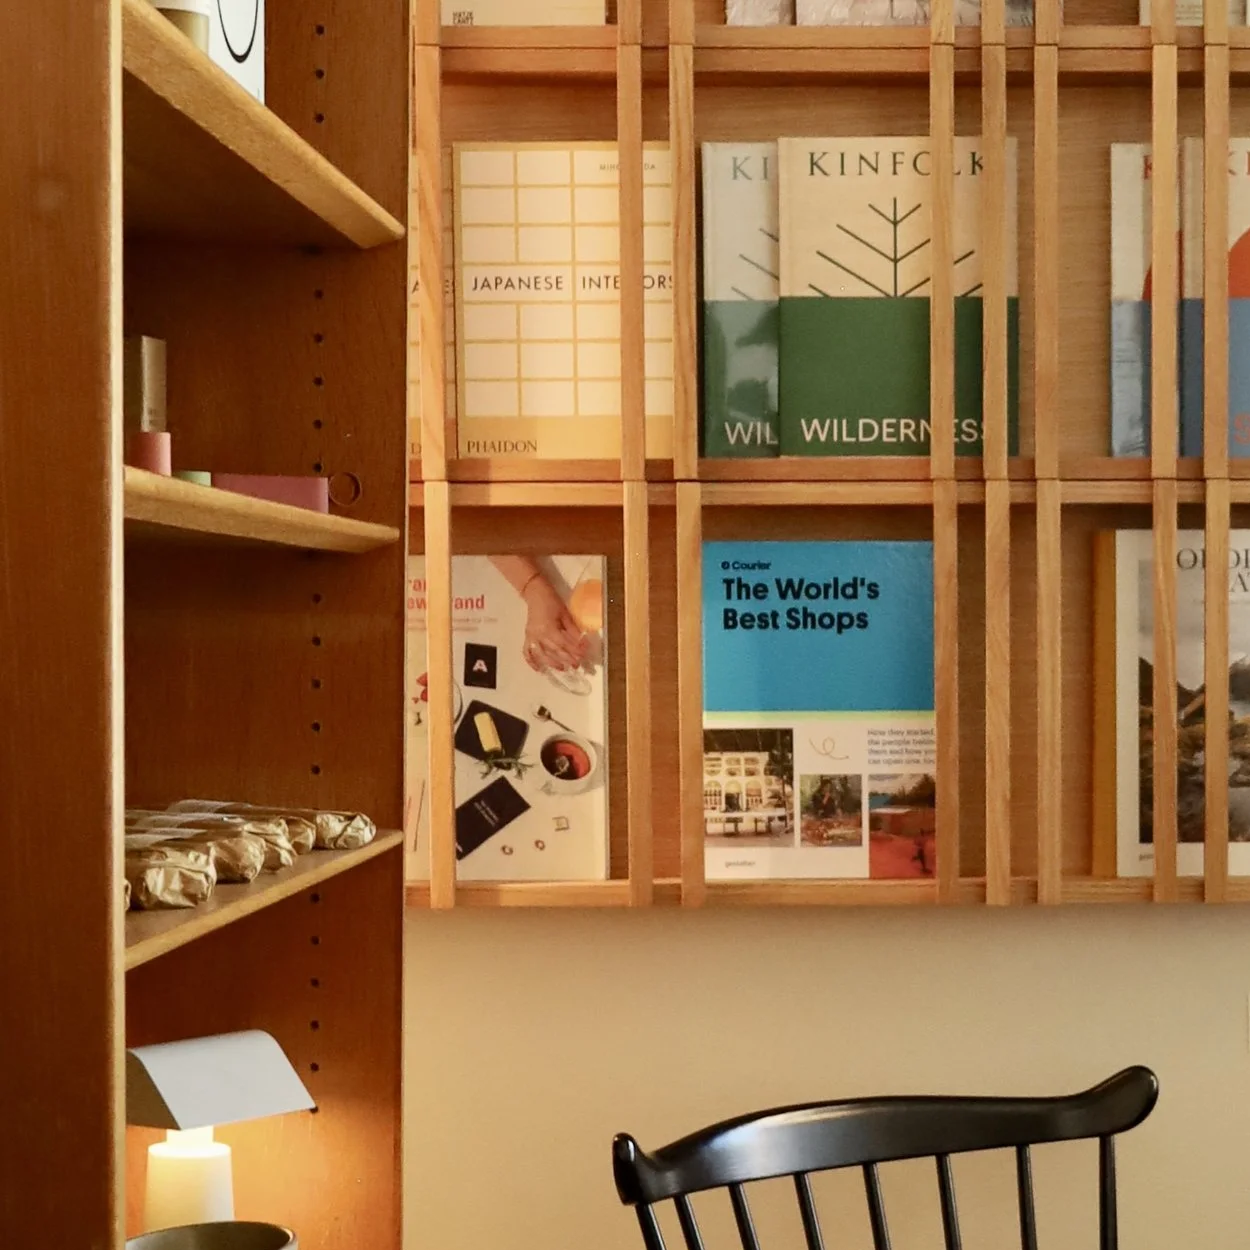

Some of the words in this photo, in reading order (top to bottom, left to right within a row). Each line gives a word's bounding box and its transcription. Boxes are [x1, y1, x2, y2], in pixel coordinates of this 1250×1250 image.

[808, 151, 984, 178] KINFOK
[471, 276, 563, 291] JAPANESE
[582, 274, 674, 290] INTEORS
[467, 440, 538, 453] PHAIDON
[732, 561, 771, 571] Courier
[723, 578, 769, 601] The
[775, 577, 880, 601] World's
[723, 608, 780, 630] Best
[786, 607, 869, 635] Shops
